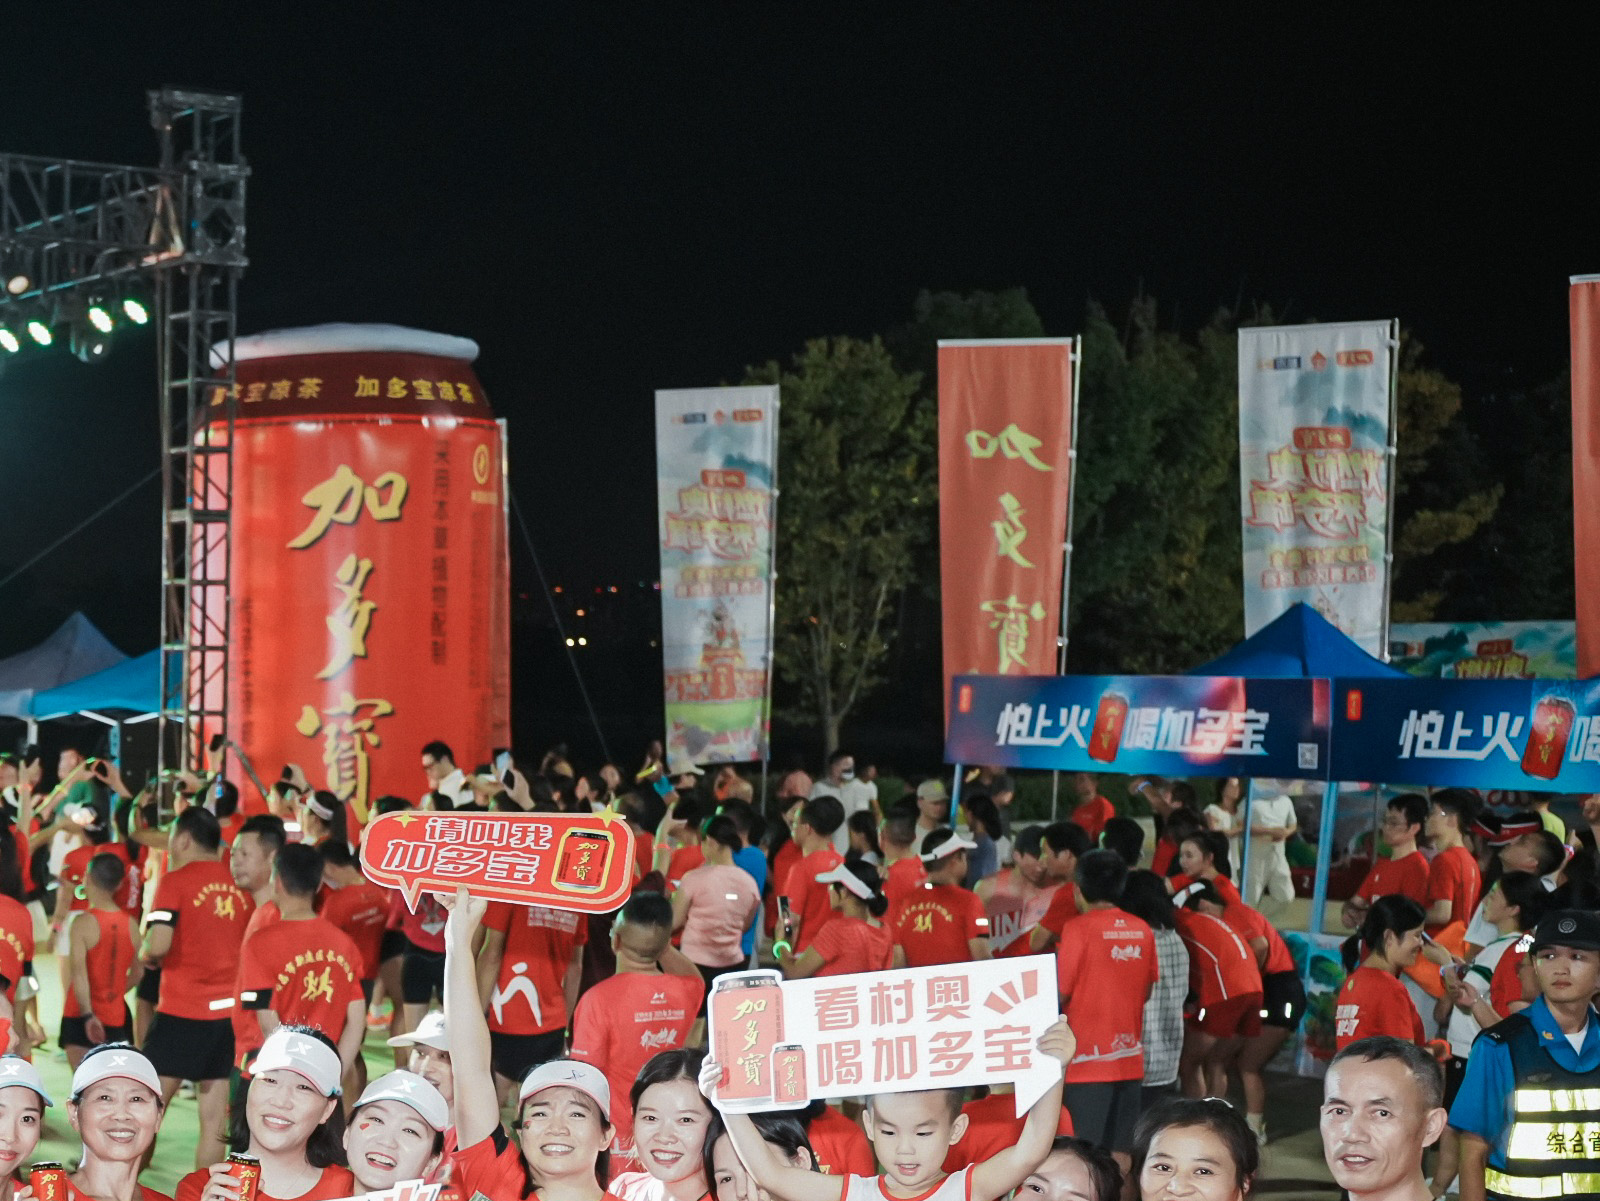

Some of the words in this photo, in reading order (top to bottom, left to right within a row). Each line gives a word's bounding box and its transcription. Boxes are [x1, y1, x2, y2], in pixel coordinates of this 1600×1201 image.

[996, 702, 1090, 750] 怕上火
[1124, 706, 1270, 757] 喝加多宝
[1399, 710, 1523, 762] 怕上火
[425, 817, 553, 850] 请叫我
[381, 840, 541, 885] 加多宝
[814, 975, 971, 1032] 看村奥
[816, 1025, 1033, 1088] 喝加多宝
